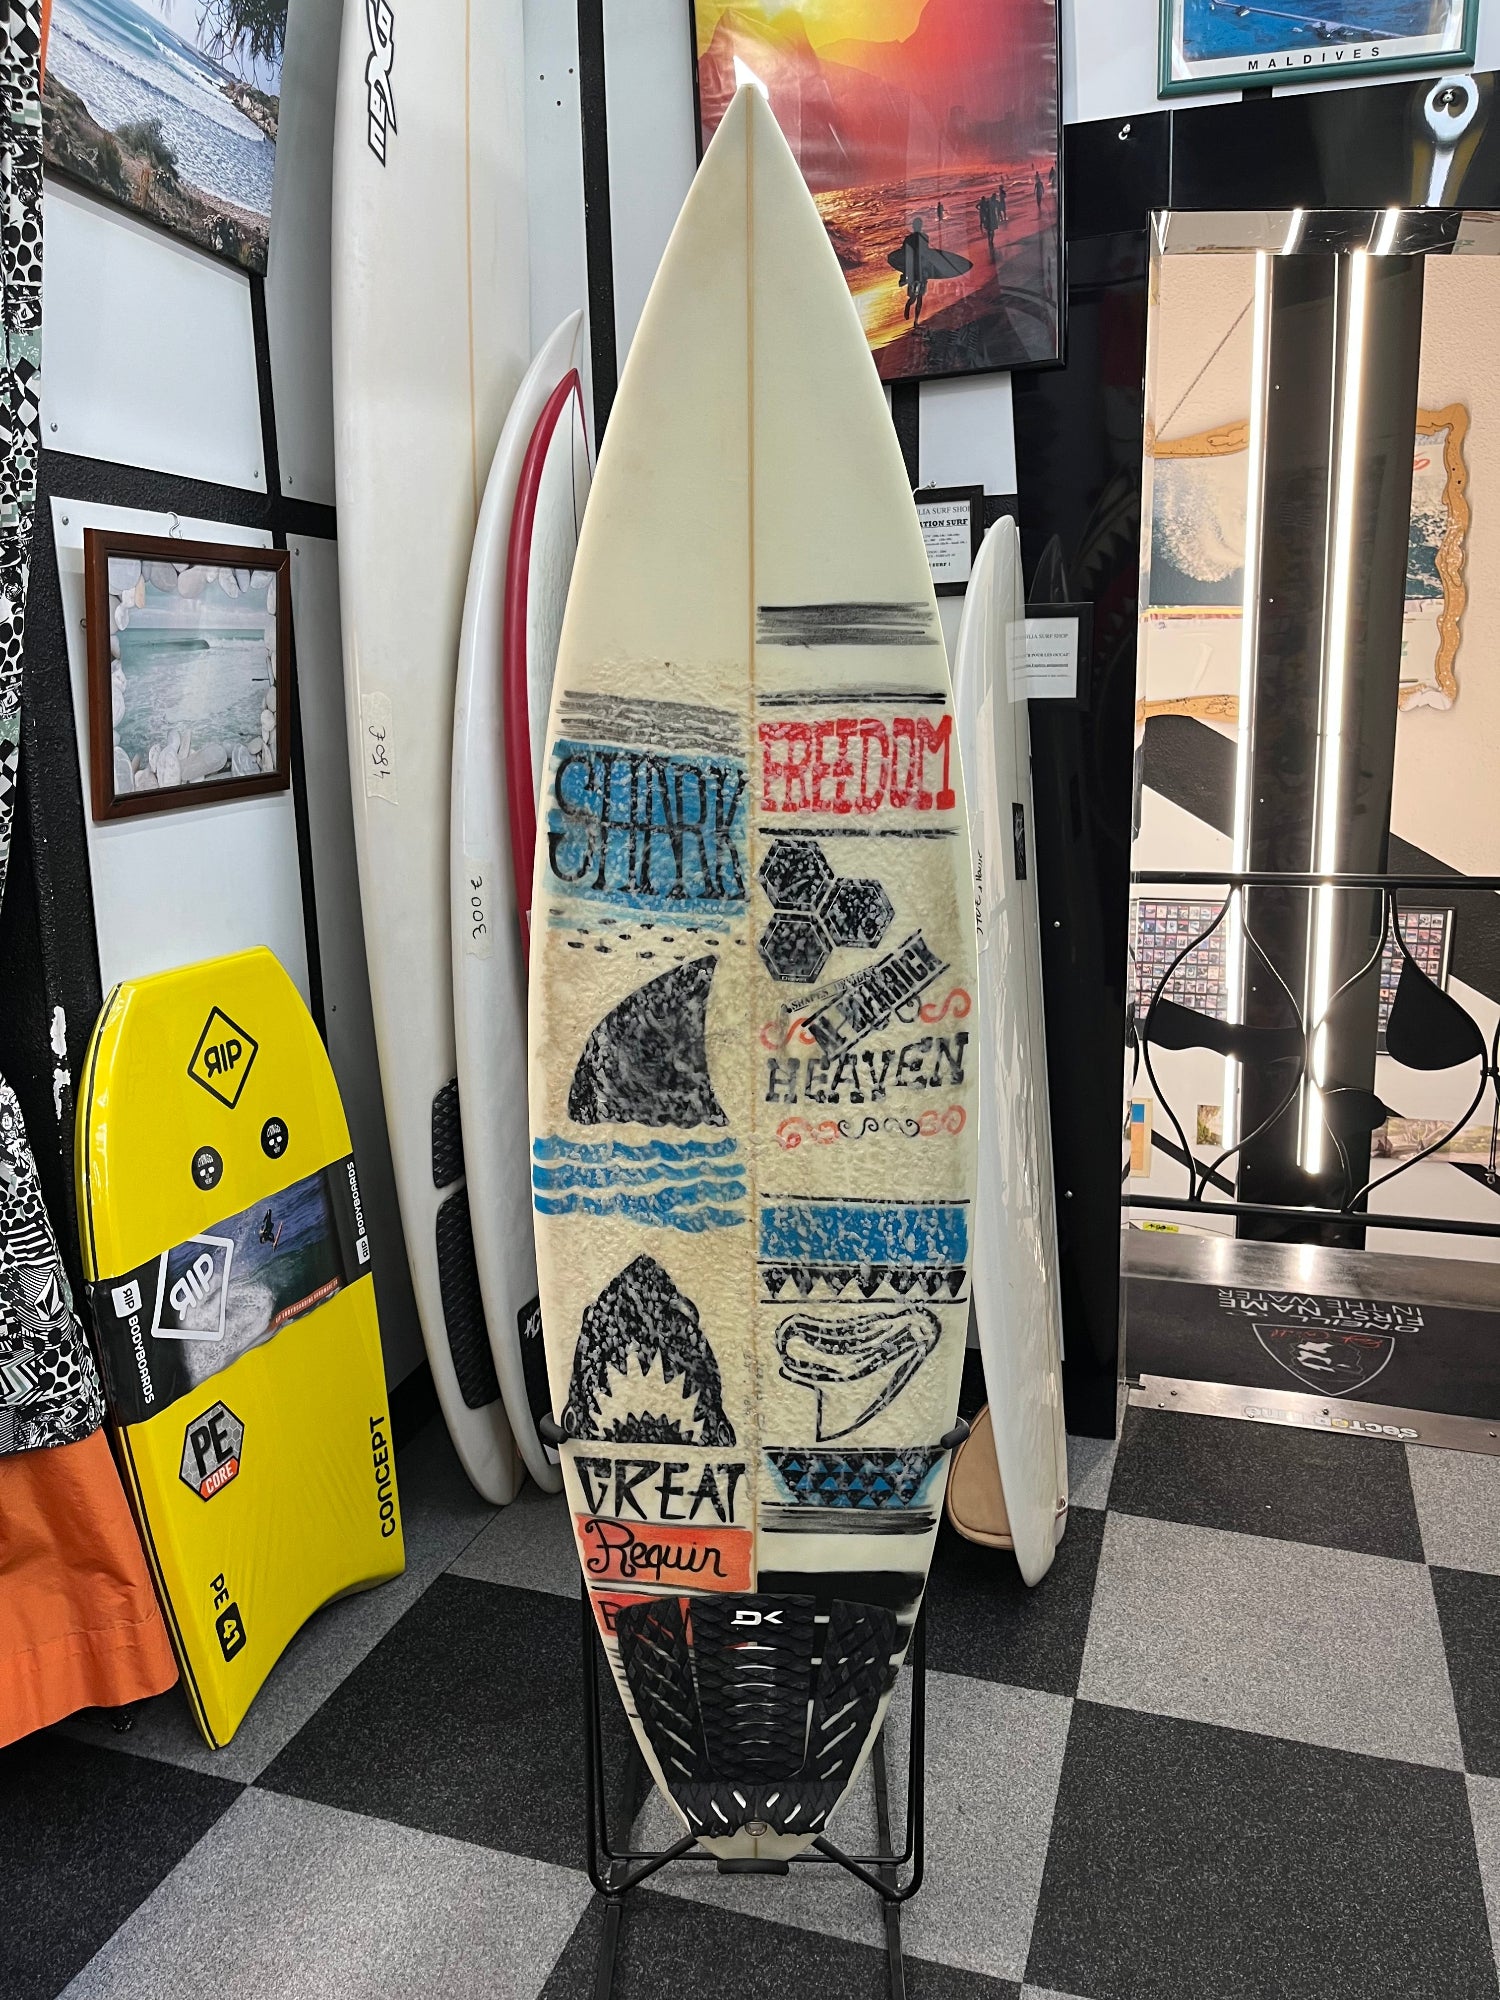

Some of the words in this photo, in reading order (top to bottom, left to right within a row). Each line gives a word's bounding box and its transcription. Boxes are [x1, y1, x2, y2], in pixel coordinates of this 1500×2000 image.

[1248, 47, 1380, 71] MALDIVES
[919, 520, 944, 528] ATION
[946, 518, 969, 526] SURF
[933, 505, 951, 515] SURF
[758, 714, 956, 814] FREEDOM
[548, 752, 748, 900] SHARK
[203, 1038, 242, 1078] RIP
[766, 1032, 969, 1104] HEAVEN
[346, 1161, 366, 1236] BODYBOARDS
[361, 1240, 369, 1258] RIP
[122, 1288, 135, 1309] RIP
[170, 1253, 214, 1320] RIP
[1218, 1288, 1319, 1307] WATER
[1218, 1297, 1321, 1317] NAME
[1325, 1299, 1384, 1313] THE
[1331, 1309, 1425, 1327] FIRST
[1391, 1304, 1421, 1316] IN
[128, 1314, 155, 1404] BODYBOARDS
[190, 1410, 234, 1478] PE
[205, 1462, 235, 1494] CORE
[574, 1456, 746, 1523] GREAT
[585, 1519, 728, 1581] Requin
[210, 1572, 229, 1610] PE
[223, 1618, 241, 1650] 41
